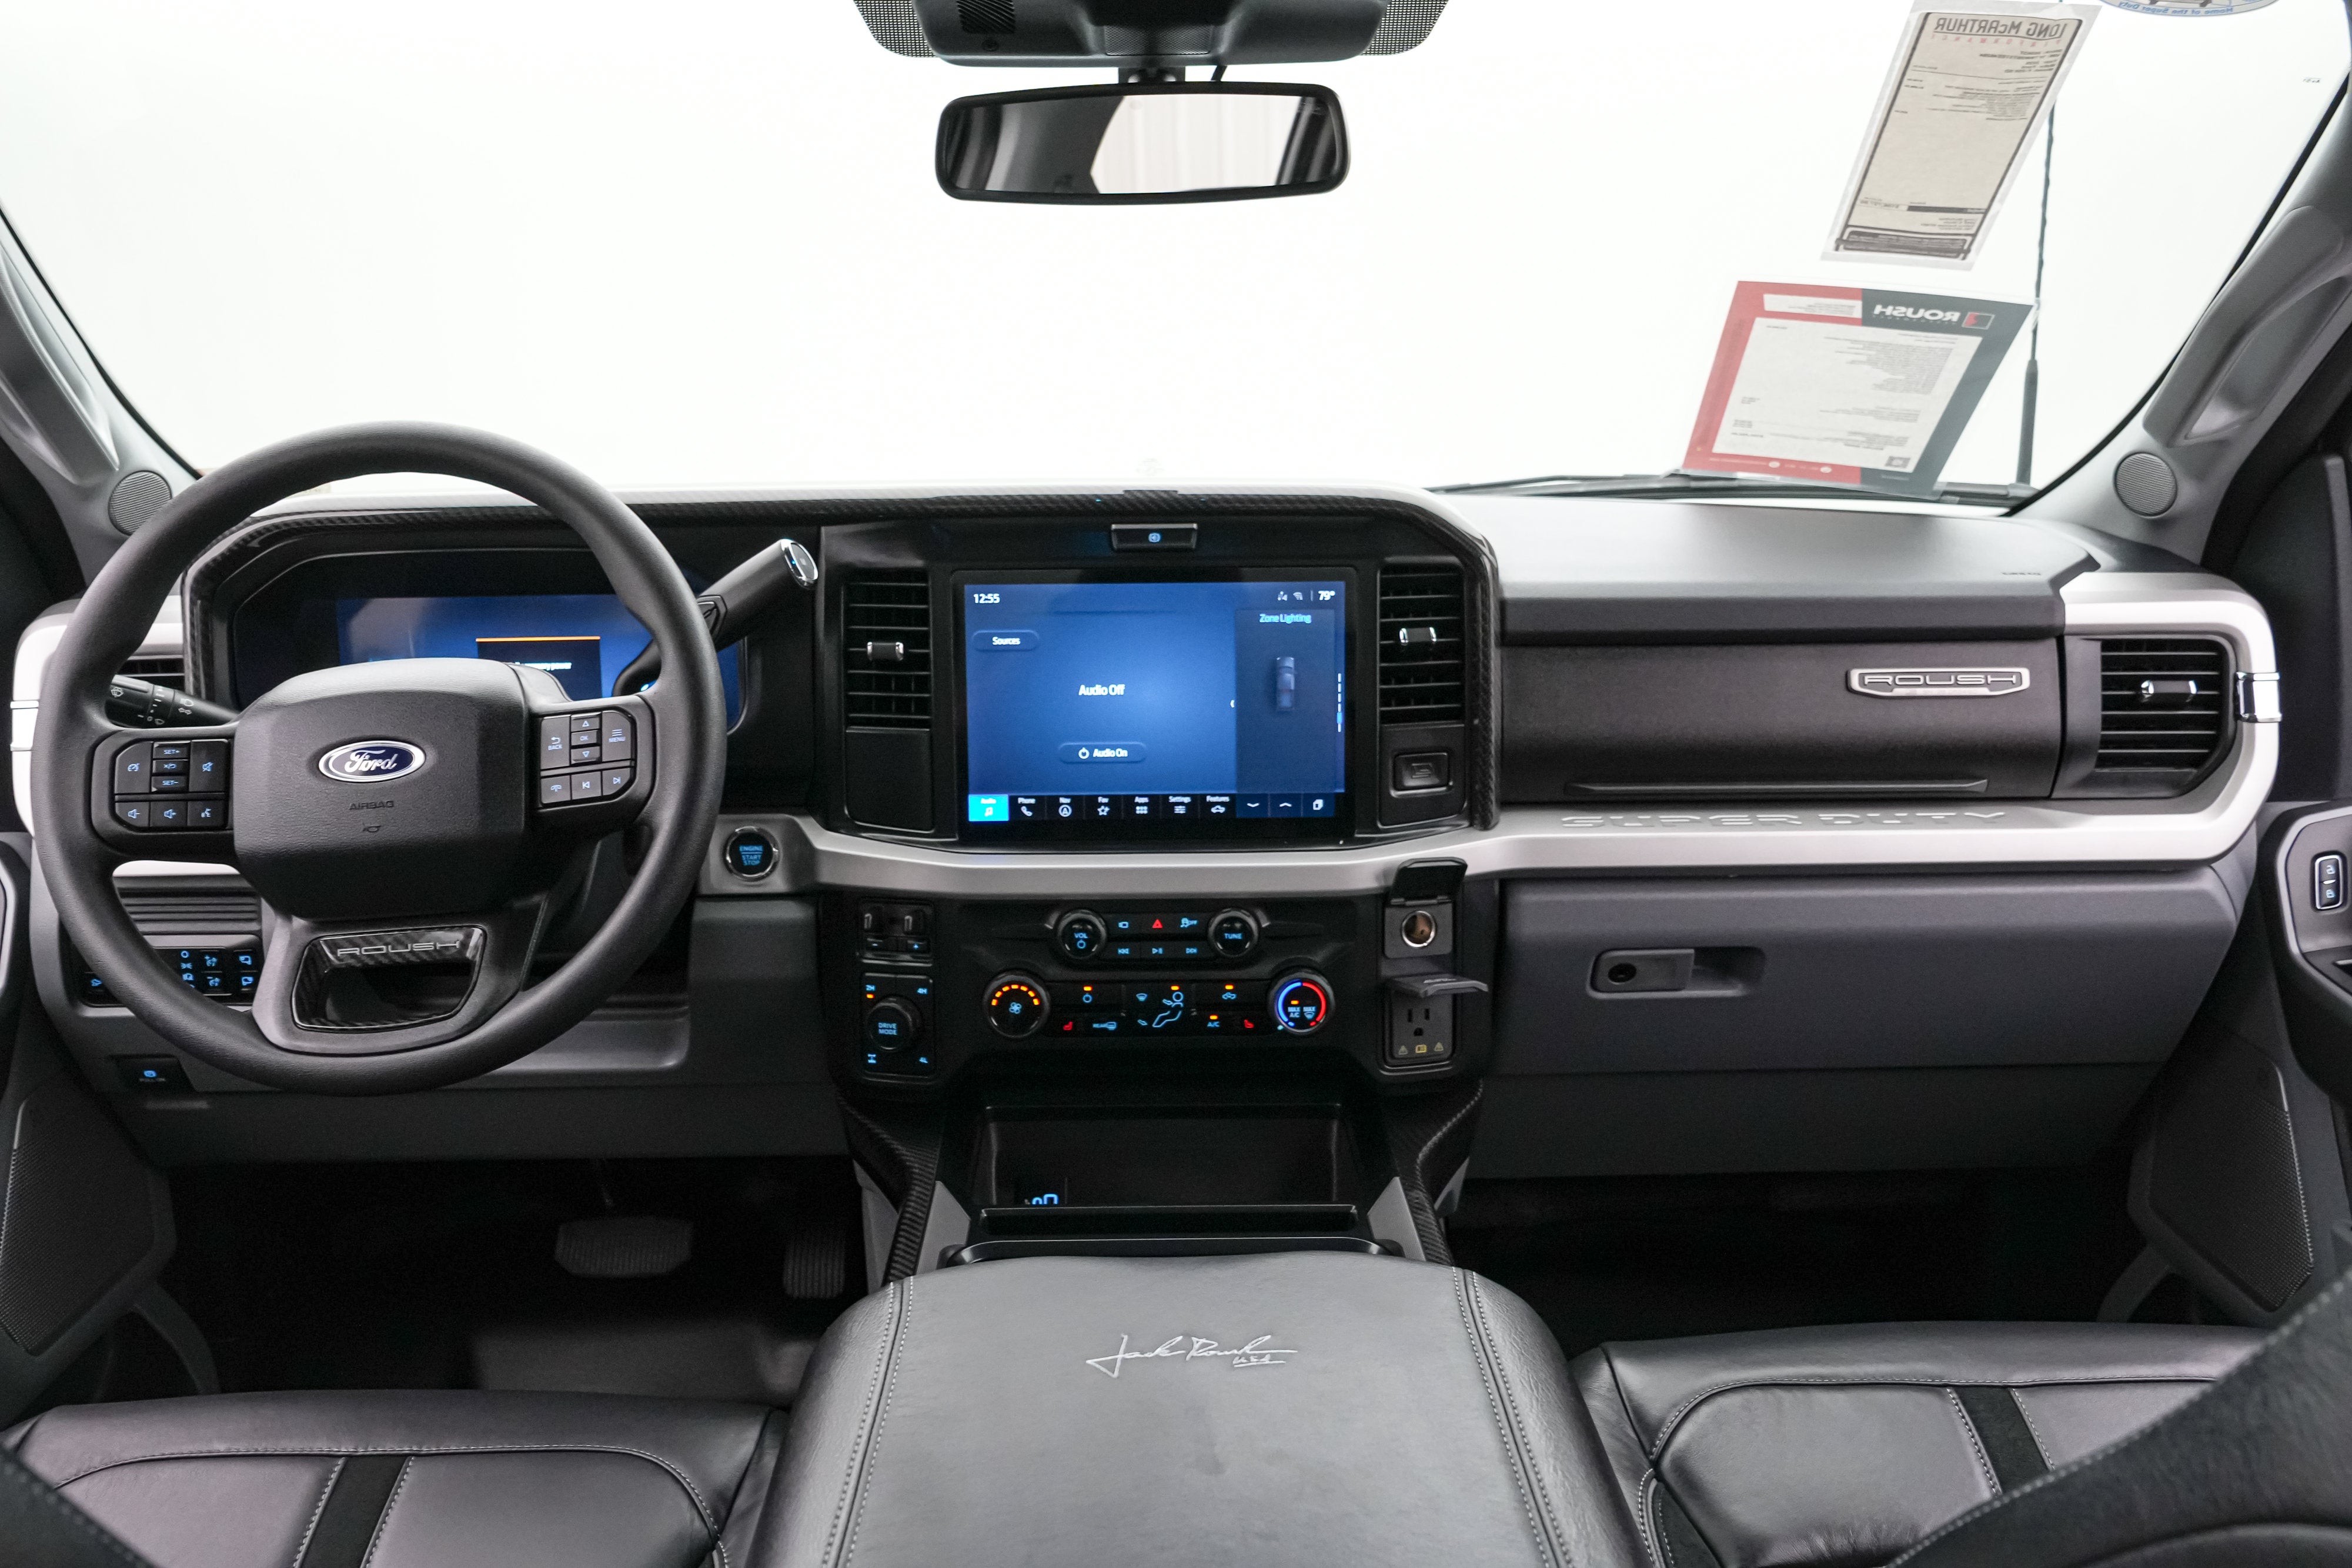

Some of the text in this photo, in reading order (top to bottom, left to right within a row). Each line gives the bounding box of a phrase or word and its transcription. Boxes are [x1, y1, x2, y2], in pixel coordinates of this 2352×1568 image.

[974, 593, 1000, 604] 12:55
[1259, 613, 1312, 624] Zone Lighting
[993, 637, 1021, 645] Sources
[1865, 674, 2016, 686] ROUSH
[1078, 684, 1125, 696] Audio Off
[1093, 748, 1128, 757] Audio On
[345, 750, 399, 773] Ford
[349, 800, 395, 810] AIRBAG
[1561, 812, 2005, 829] SUPER DUTY
[337, 941, 460, 957] ROUSH
[1085, 1334, 1186, 1379] Jack
